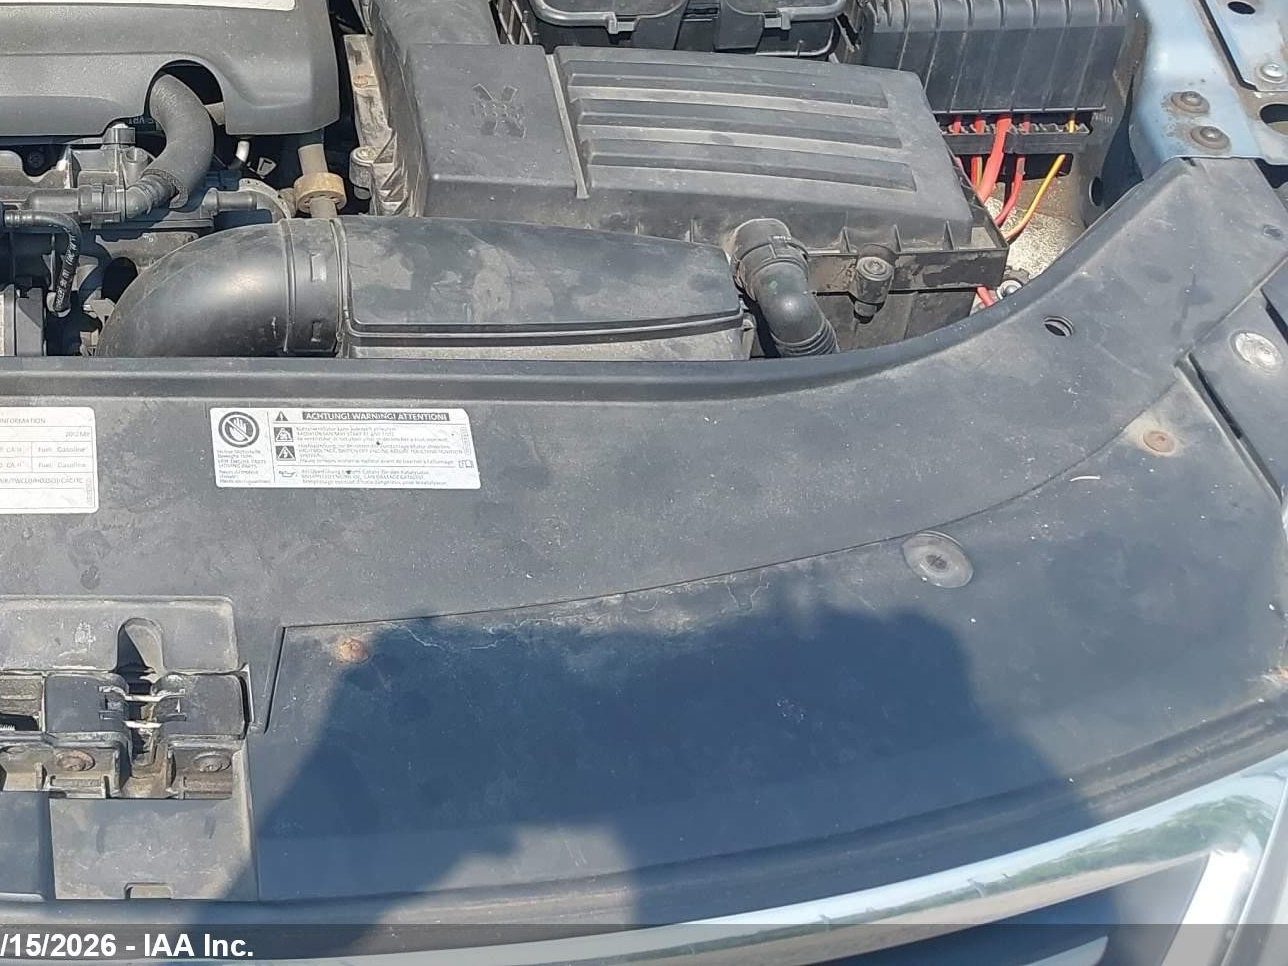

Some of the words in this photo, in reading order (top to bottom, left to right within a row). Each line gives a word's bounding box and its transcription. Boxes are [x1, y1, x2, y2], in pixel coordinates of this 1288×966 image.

[305, 411, 352, 421] ACHTUNG!
[352, 411, 397, 421] WARNING!
[397, 412, 447, 422] ATTENTION!
